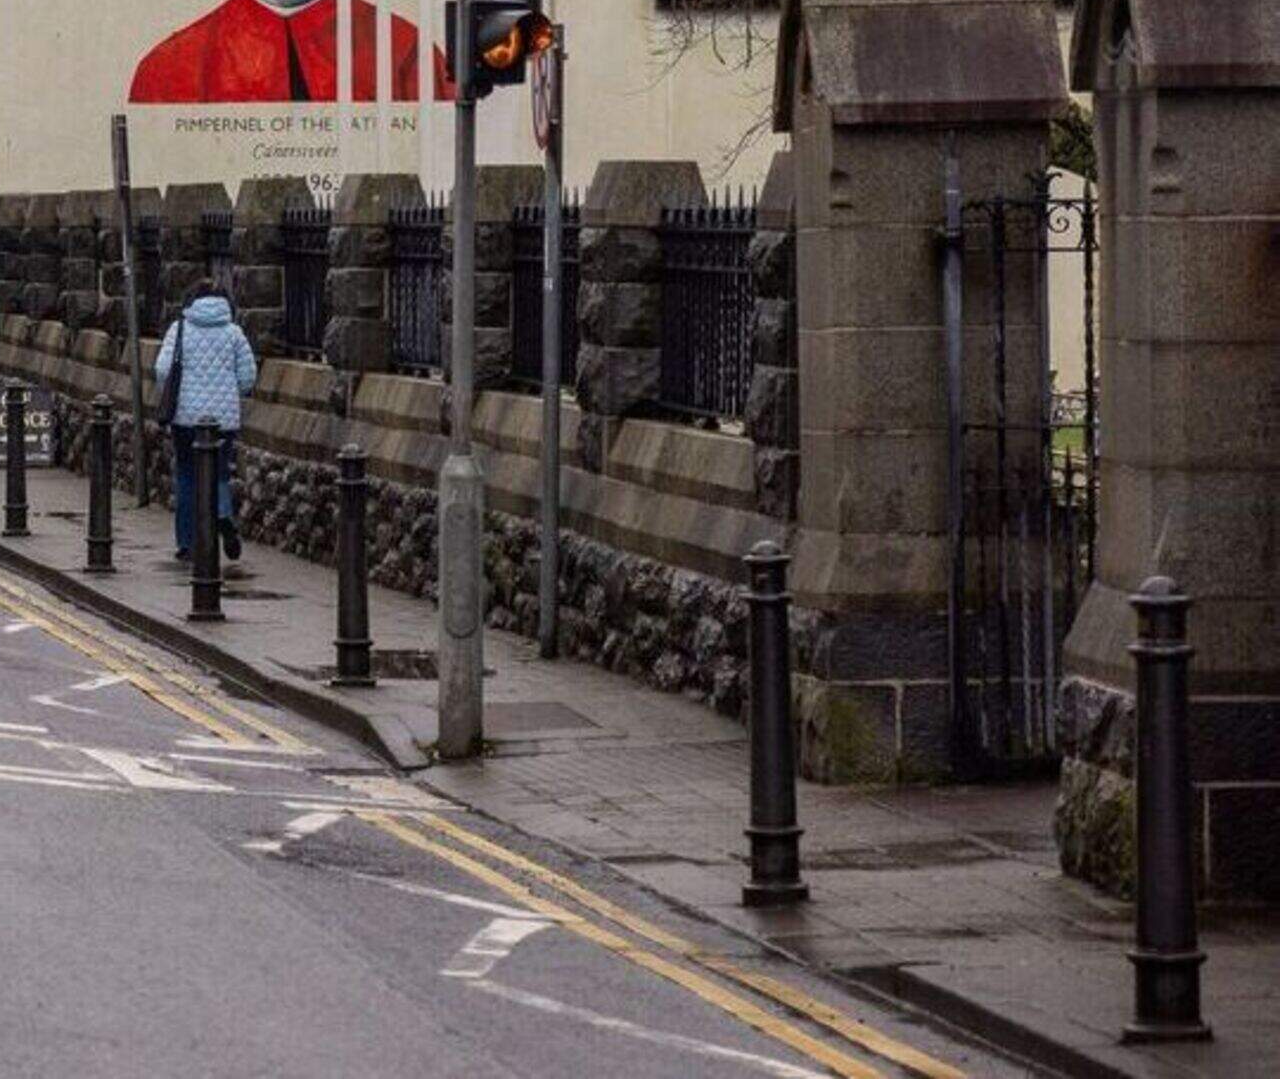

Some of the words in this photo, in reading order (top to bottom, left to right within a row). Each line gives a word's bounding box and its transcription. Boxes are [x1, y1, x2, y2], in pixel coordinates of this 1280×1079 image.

[174, 116, 266, 132] PIMPERNEL
[270, 116, 294, 133] OF
[299, 116, 334, 132] THE
[339, 116, 417, 132] ATIAN
[308, 172, 340, 191] 96
